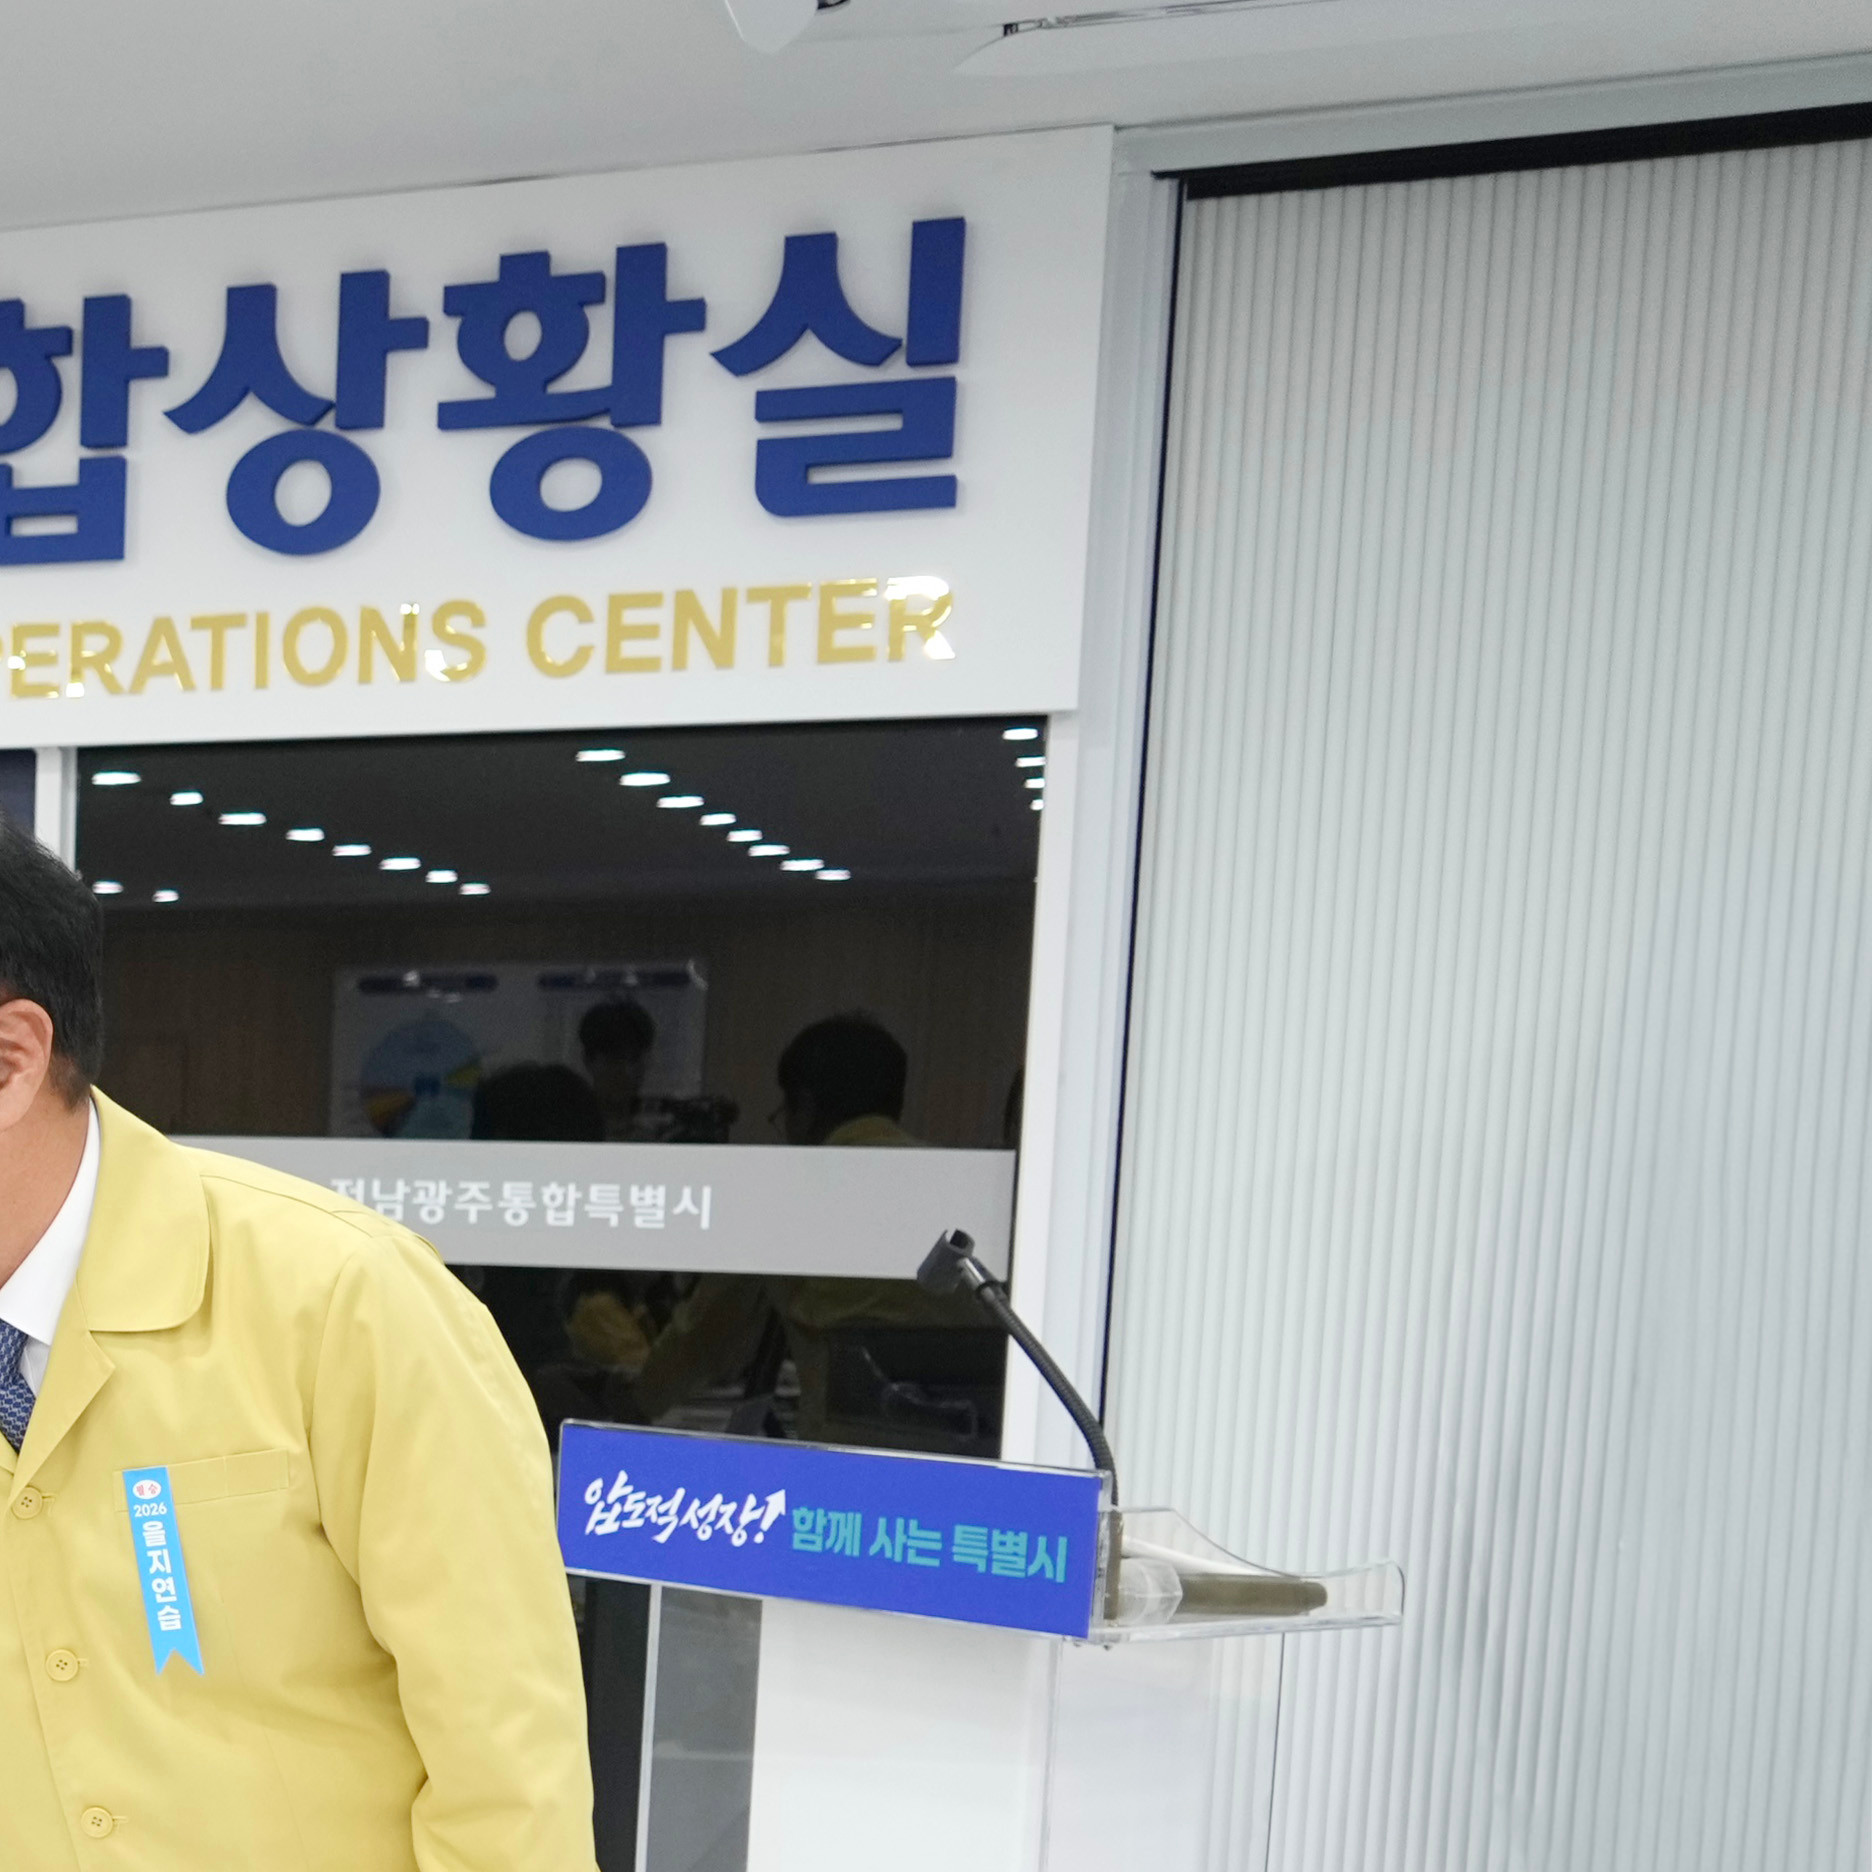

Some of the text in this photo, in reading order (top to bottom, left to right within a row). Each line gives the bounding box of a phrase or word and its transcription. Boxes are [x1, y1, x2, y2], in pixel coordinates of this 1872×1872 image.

[524, 577, 955, 680] CENTER
[133, 1502, 168, 1518] 2026
[584, 1469, 687, 1544] 압도적
[791, 1505, 863, 1558] 함께
[869, 1516, 943, 1568] 사는
[952, 1523, 1068, 1583] 특별시
[142, 1520, 182, 1632] 을지연습
